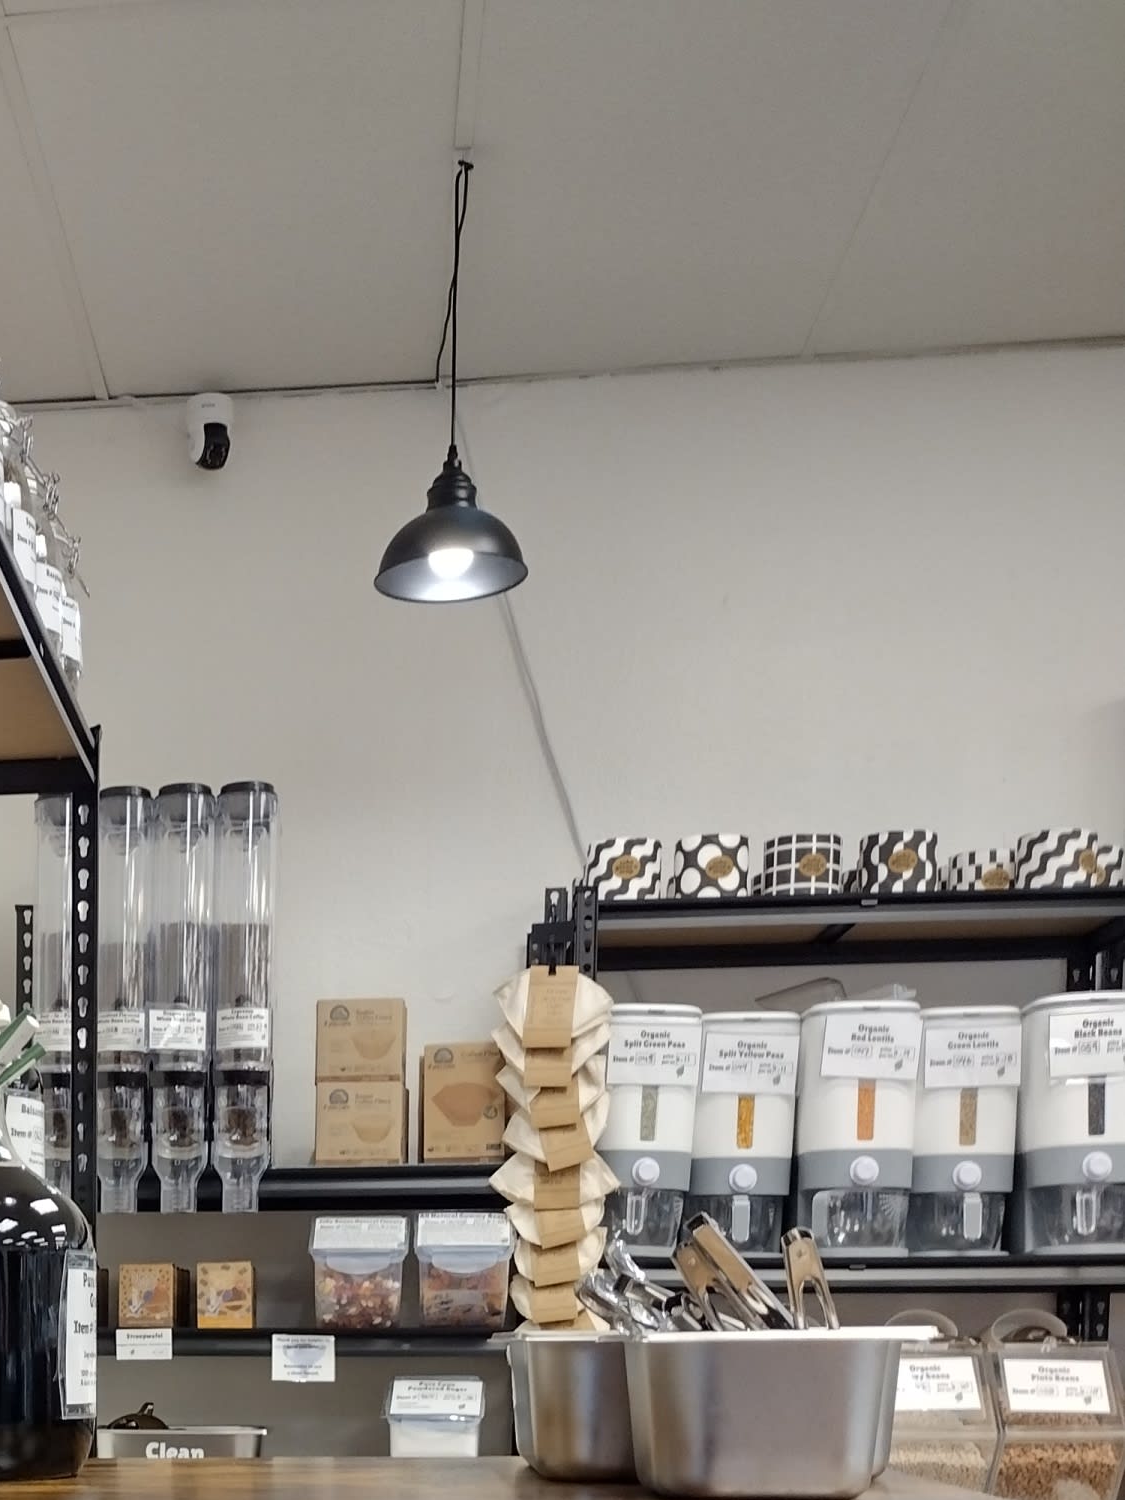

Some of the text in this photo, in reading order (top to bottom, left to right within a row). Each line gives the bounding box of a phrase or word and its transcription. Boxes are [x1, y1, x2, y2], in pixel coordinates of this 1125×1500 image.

[1082, 1017, 1114, 1029] Organic
[858, 1024, 890, 1034] Organic
[1074, 1028, 1123, 1039] Black Beans
[640, 1030, 671, 1040] Organic
[851, 1033, 895, 1043] Red Lentils
[958, 1031, 990, 1040] Organic
[624, 1039, 686, 1049] Split Green Peas
[737, 1040, 768, 1050] Organic
[947, 1040, 999, 1050] Green Lentils
[719, 1050, 785, 1059] Split Yellow Peas
[10, 1127, 27, 1138] Item
[909, 1364, 941, 1373] Organic
[1038, 1366, 1071, 1375] Organic
[1031, 1374, 1080, 1383] Pinto Beans
